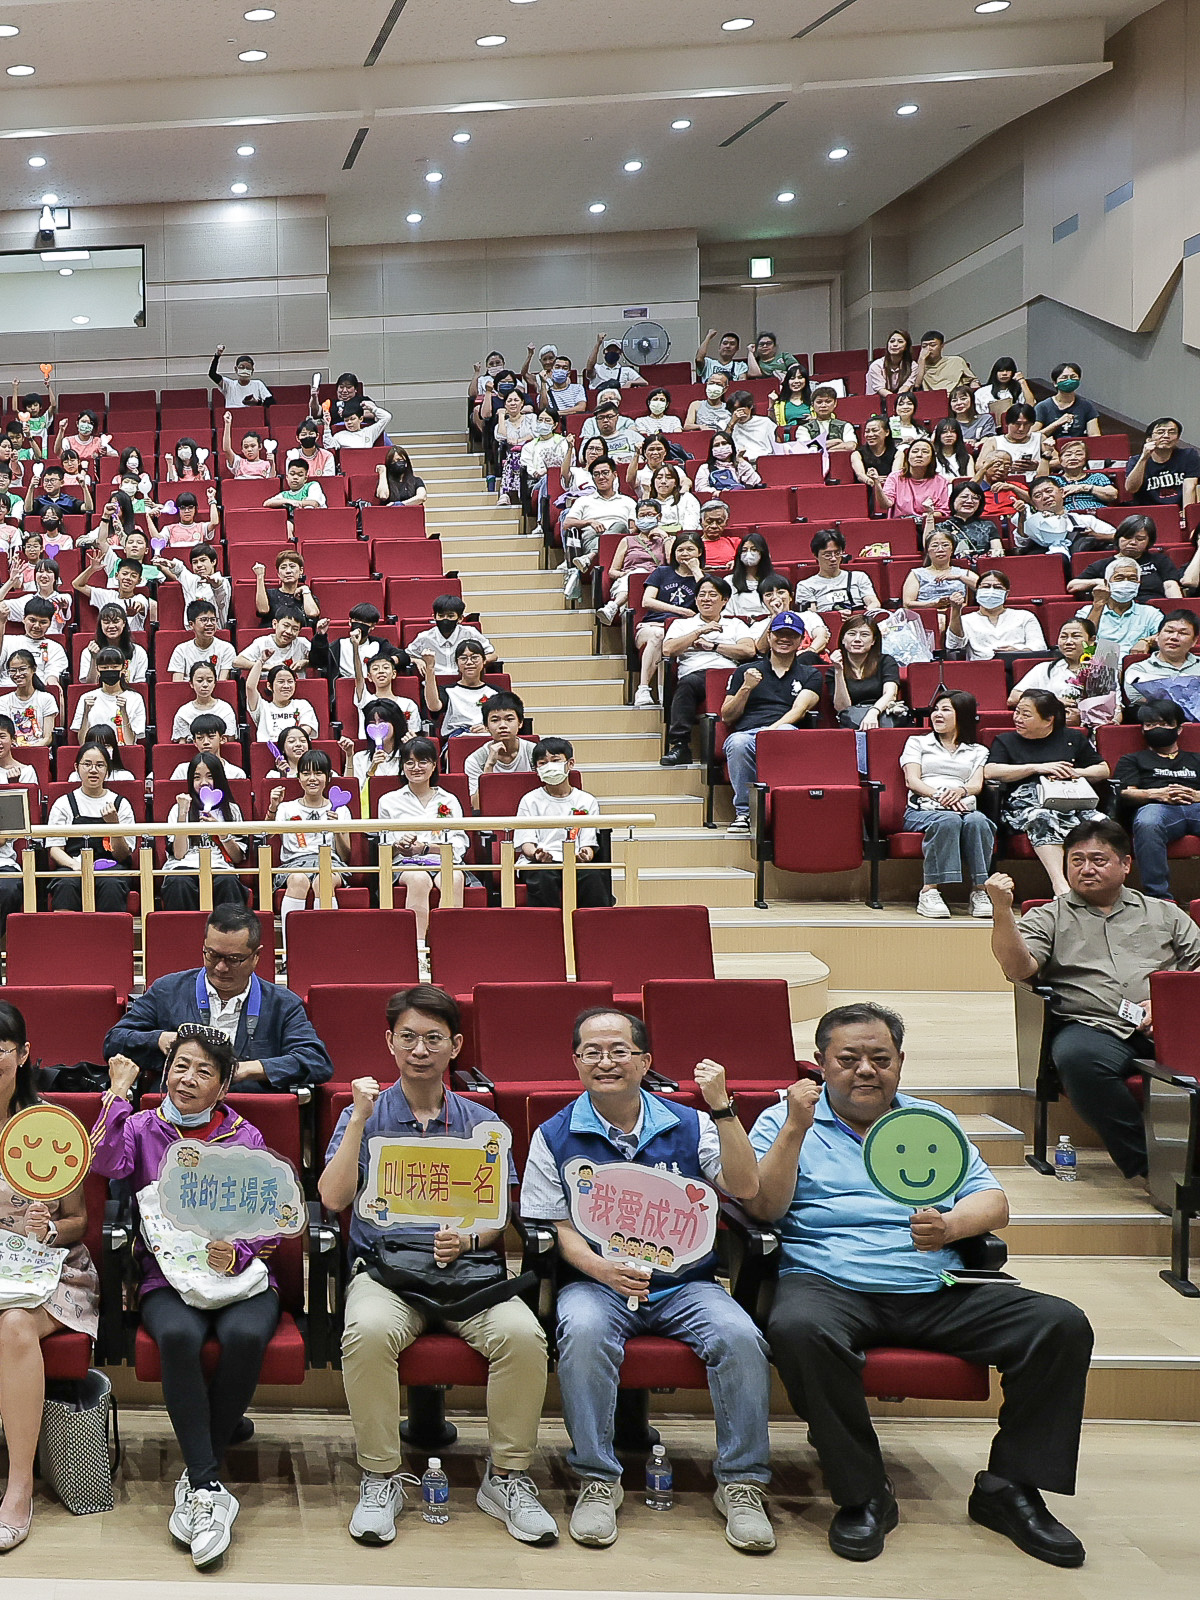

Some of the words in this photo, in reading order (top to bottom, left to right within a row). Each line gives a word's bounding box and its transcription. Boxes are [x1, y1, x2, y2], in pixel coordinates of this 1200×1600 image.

[180, 1171, 278, 1215] 我的主場秀
[384, 1160, 494, 1204] 叫我第一名
[588, 1182, 698, 1249] 我愛成功
